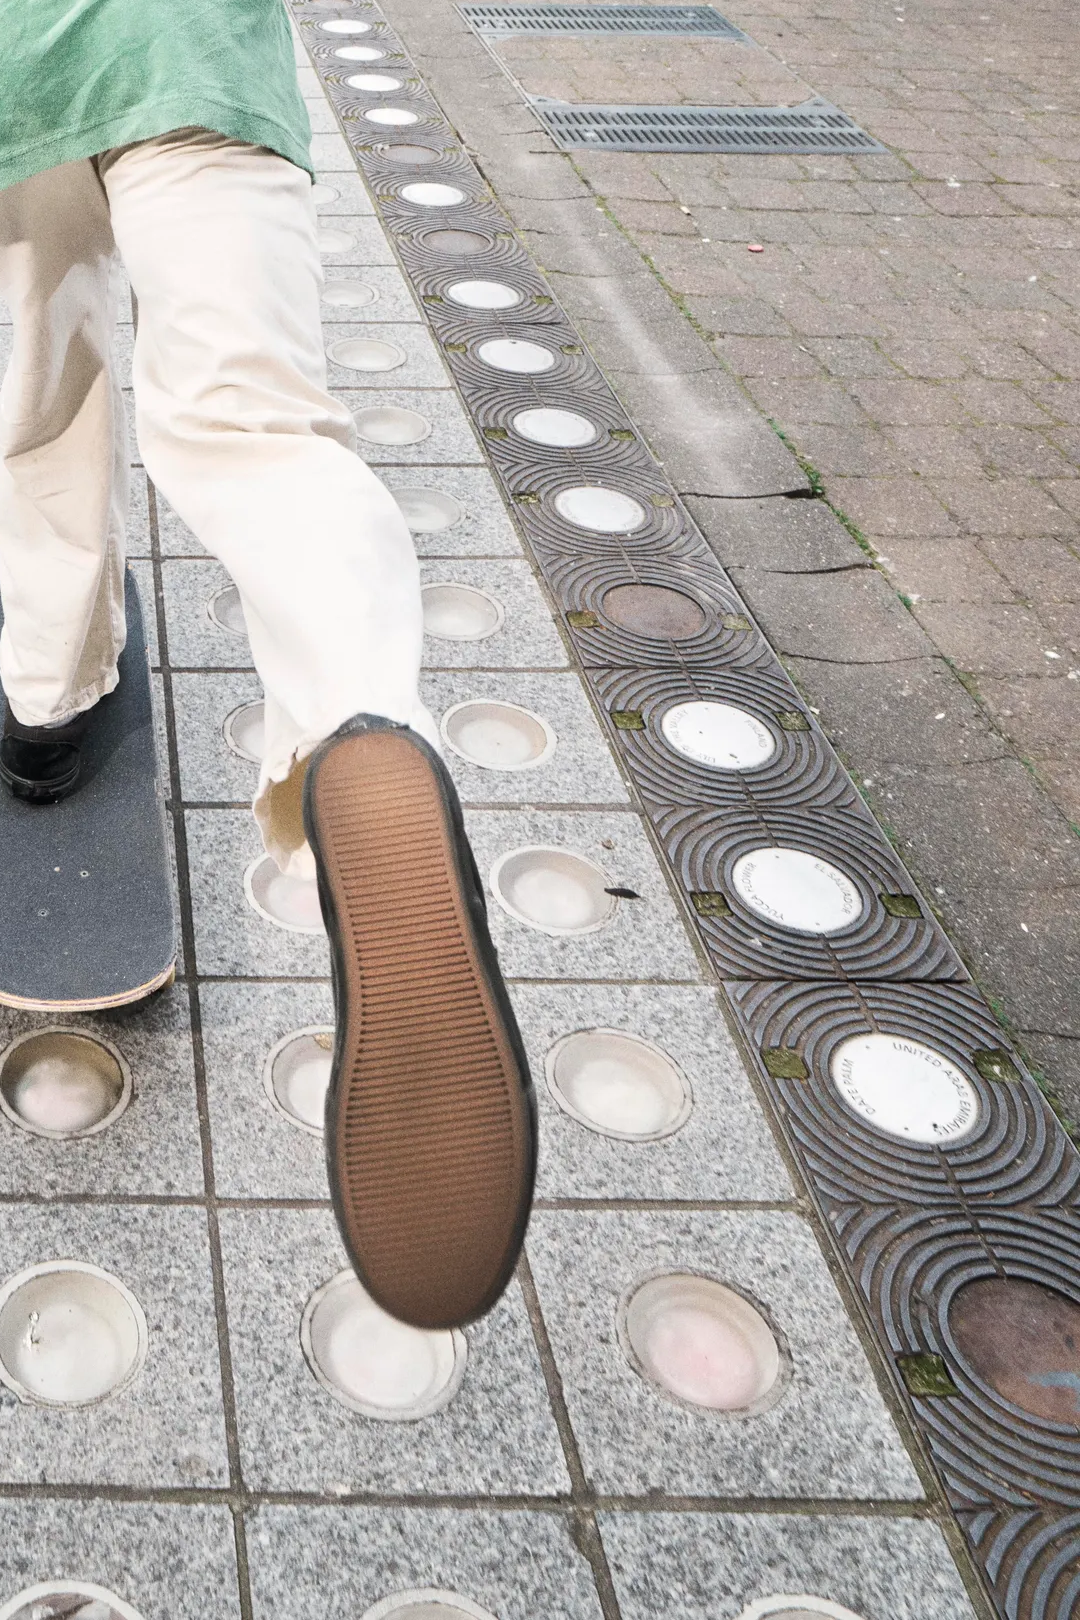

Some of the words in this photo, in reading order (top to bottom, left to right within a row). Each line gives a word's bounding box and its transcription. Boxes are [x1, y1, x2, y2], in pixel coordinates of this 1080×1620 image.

[741, 862, 757, 893] FLOWER
[814, 863, 826, 873] EL
[827, 872, 853, 915] SALVADOR
[750, 894, 784, 920] YUCCA
[892, 1042, 942, 1068] UNITED
[840, 1058, 854, 1086] PALM
[942, 1069, 969, 1098] ARAB
[847, 1087, 876, 1116] DATE
[933, 1099, 971, 1137] EMIRATES
